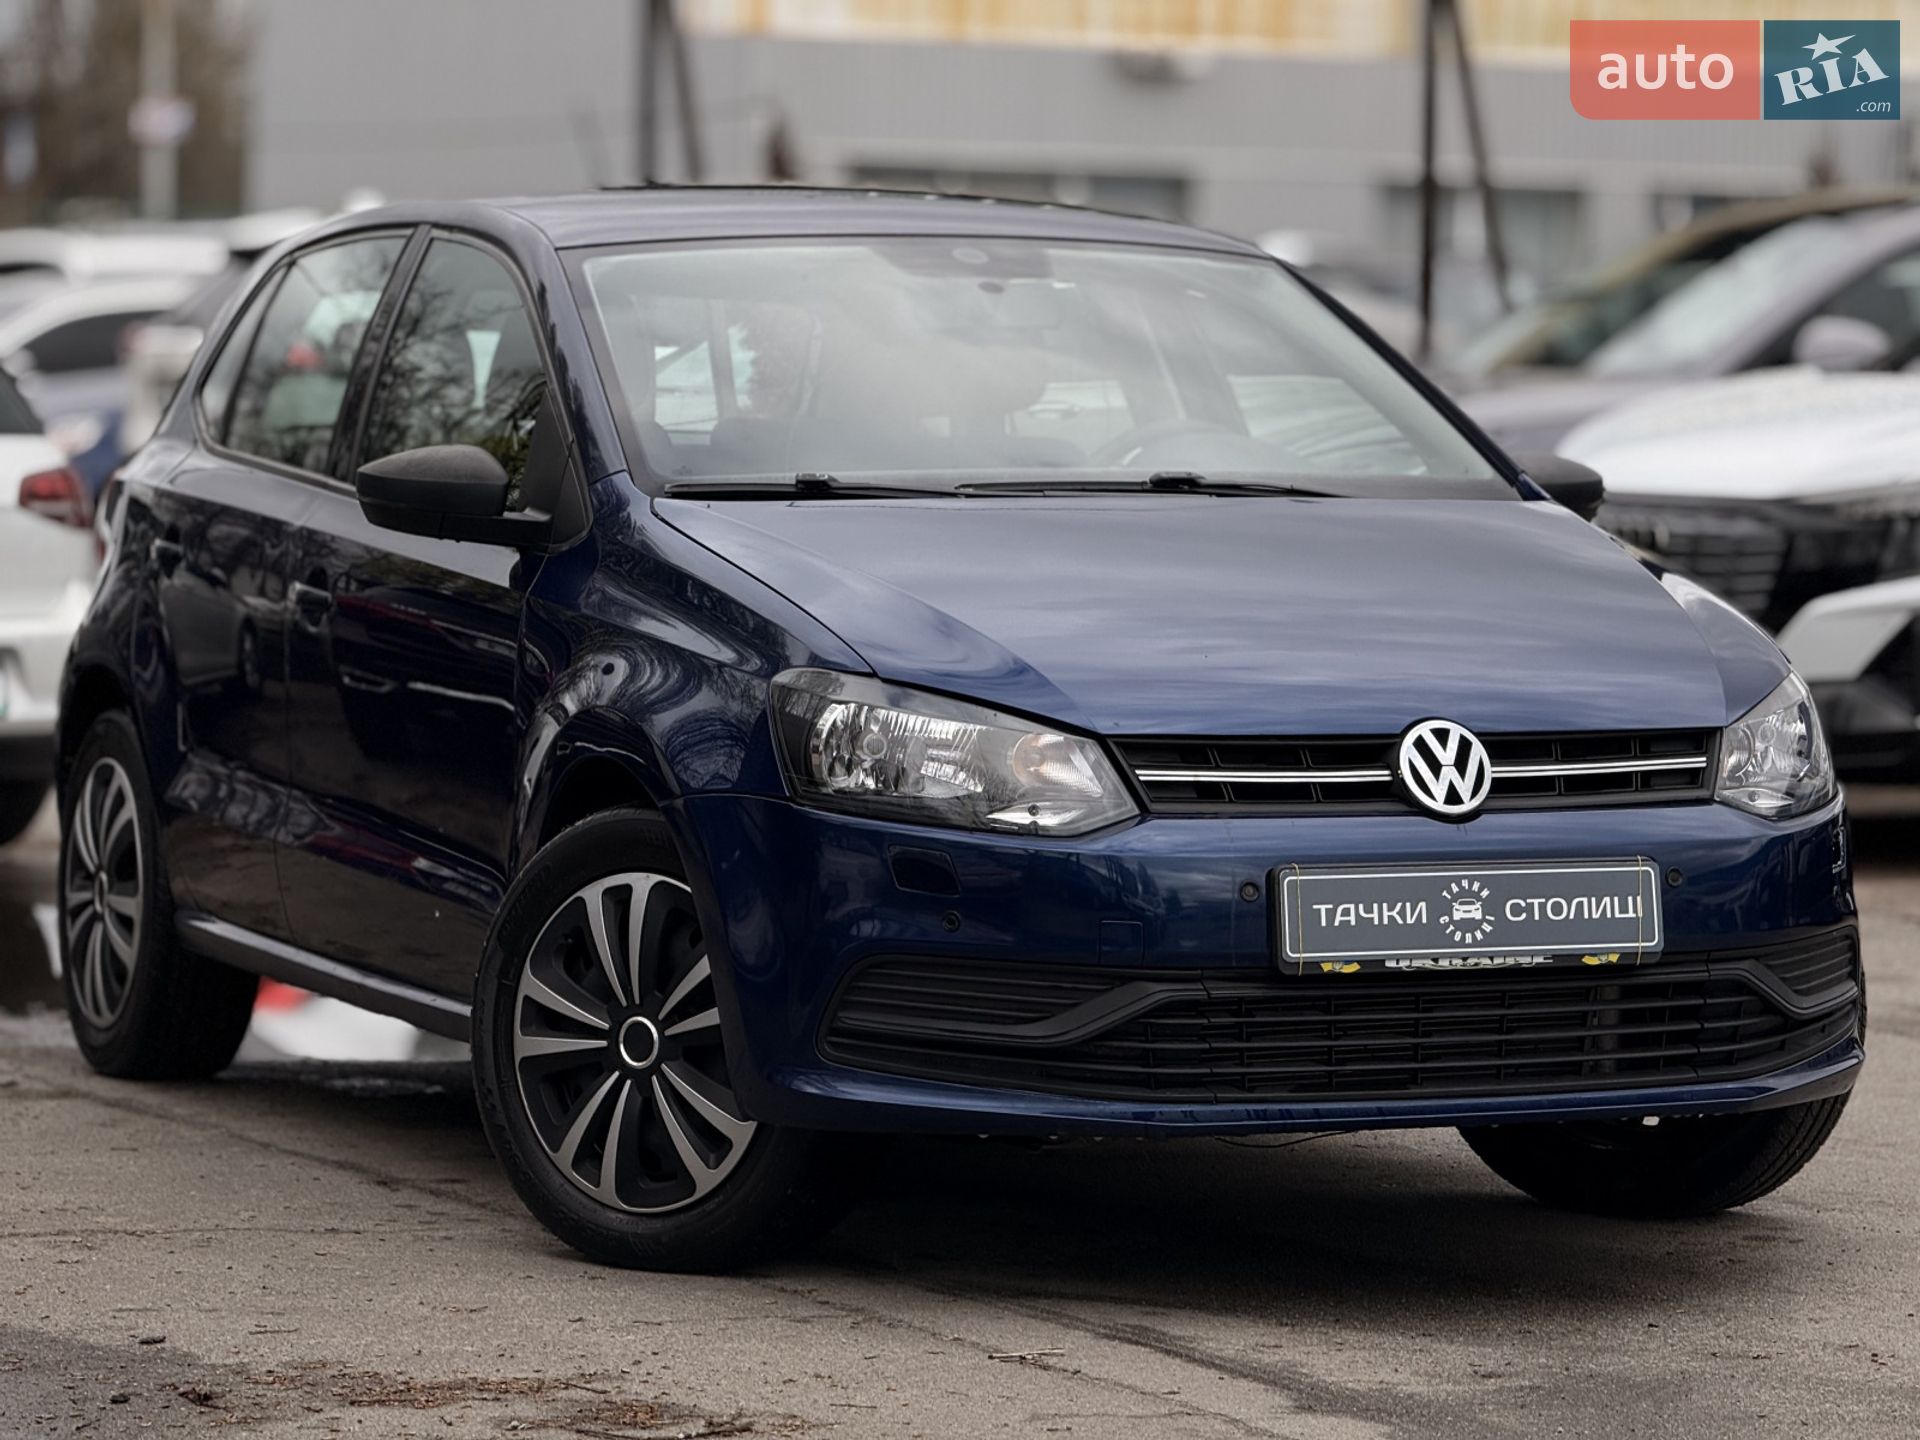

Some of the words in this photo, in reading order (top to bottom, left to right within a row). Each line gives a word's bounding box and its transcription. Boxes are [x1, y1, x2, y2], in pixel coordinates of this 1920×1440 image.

[1402, 722, 1489, 811] VW
[1441, 878, 1490, 900] ТАЧКИ
[1311, 900, 1428, 927] ТАЧКИ
